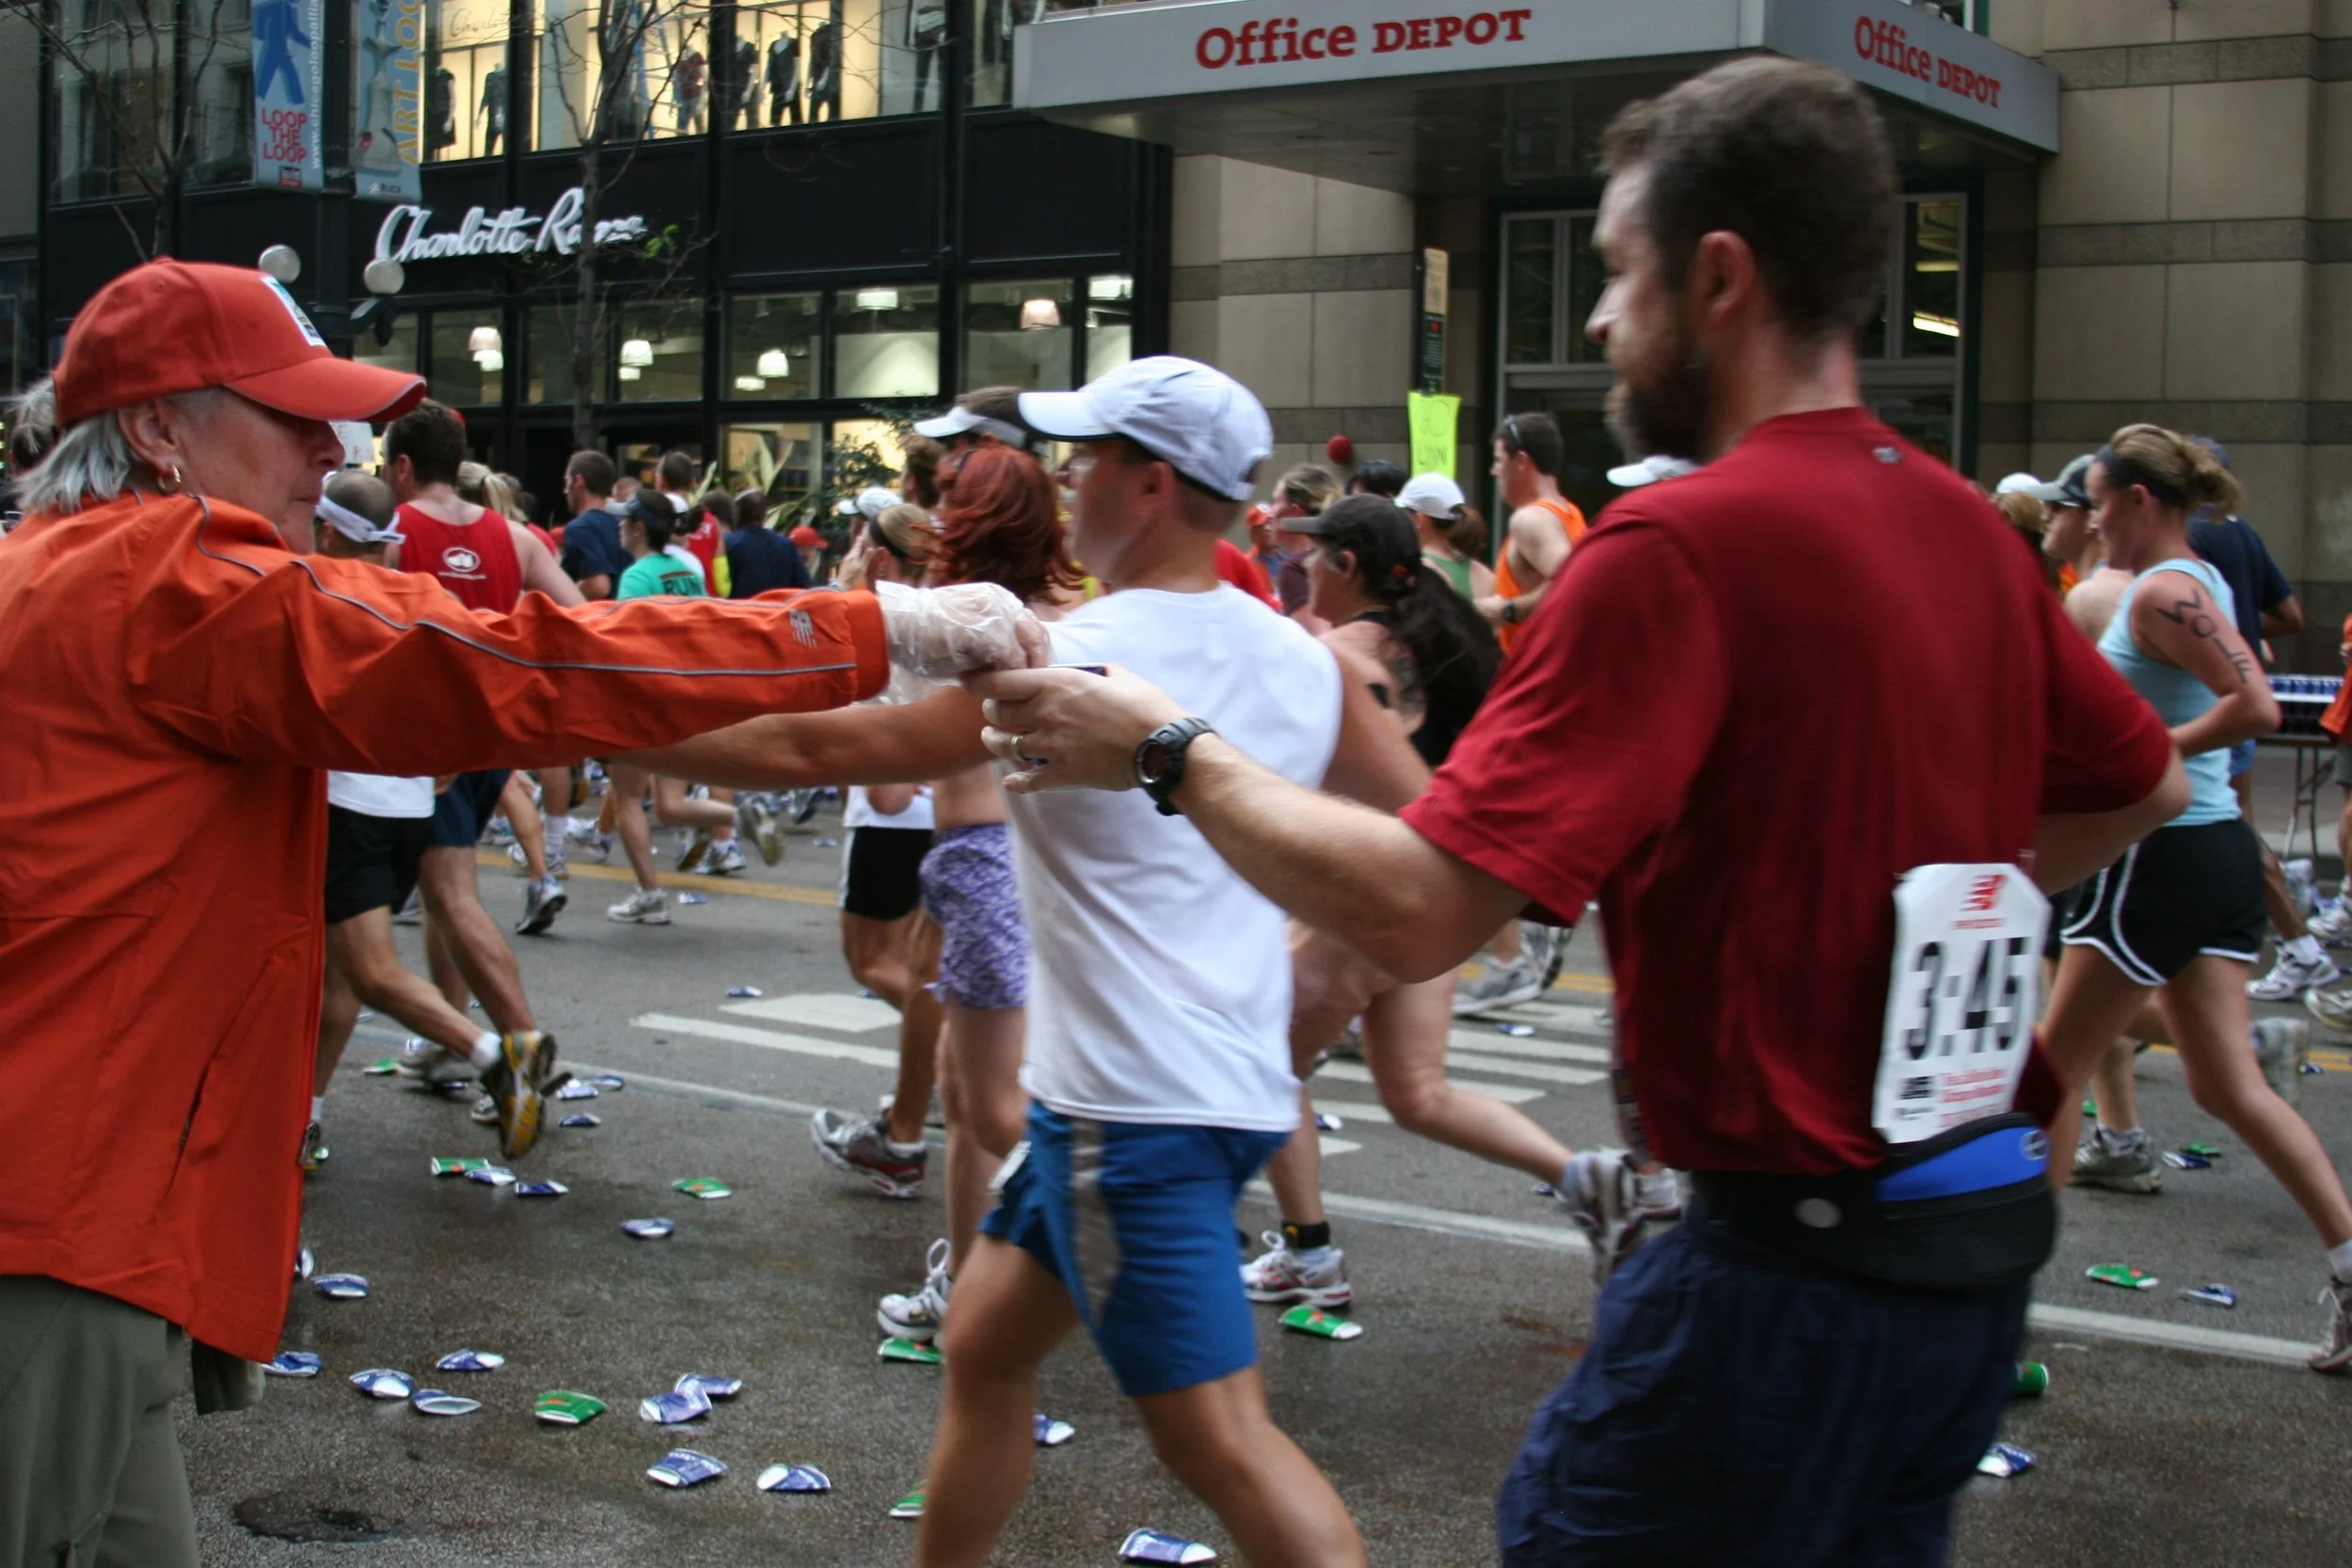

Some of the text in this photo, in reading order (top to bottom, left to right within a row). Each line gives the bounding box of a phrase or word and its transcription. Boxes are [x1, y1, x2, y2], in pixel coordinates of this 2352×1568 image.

[1196, 9, 1532, 70] Office DEPOT
[1853, 16, 2001, 108] Office DEPOT
[262, 108, 308, 130] LOOP
[268, 123, 301, 146] THE
[393, 80, 420, 166] ART
[262, 142, 307, 163] LOOP
[374, 204, 543, 264] Charlotte
[2154, 587, 2252, 684] WOLF
[1903, 937, 2032, 1060] 3:45
